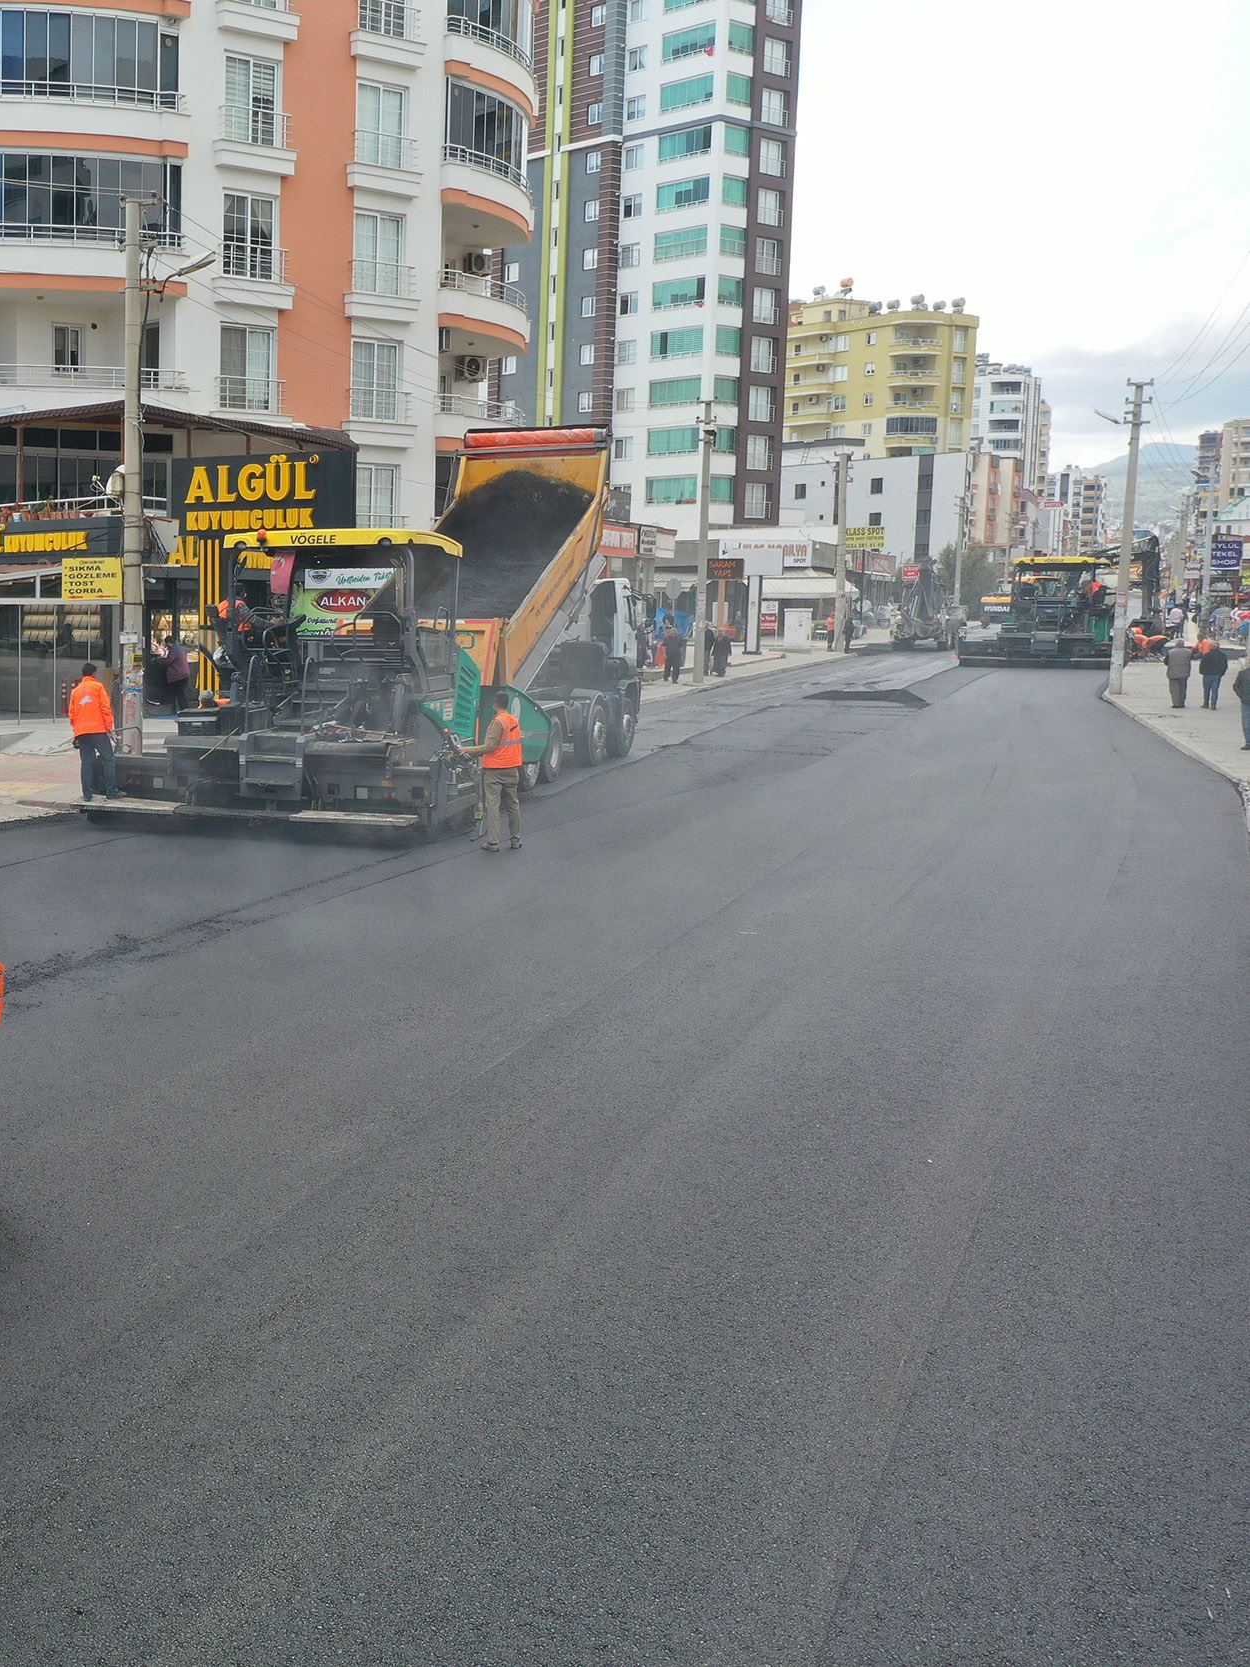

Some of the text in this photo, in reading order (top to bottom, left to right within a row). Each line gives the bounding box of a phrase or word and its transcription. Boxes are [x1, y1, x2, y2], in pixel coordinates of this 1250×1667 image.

[184, 454, 317, 504] ALGÜL
[185, 507, 315, 532] KUYUMCULUK
[867, 526, 885, 536] SPOT
[4, 531, 89, 553] KUYUMCULUK
[290, 533, 337, 545] VÖGELE
[68, 572, 118, 580] GÖZLEME
[68, 587, 104, 595] ÇORBA
[320, 596, 366, 607] ALKAN
